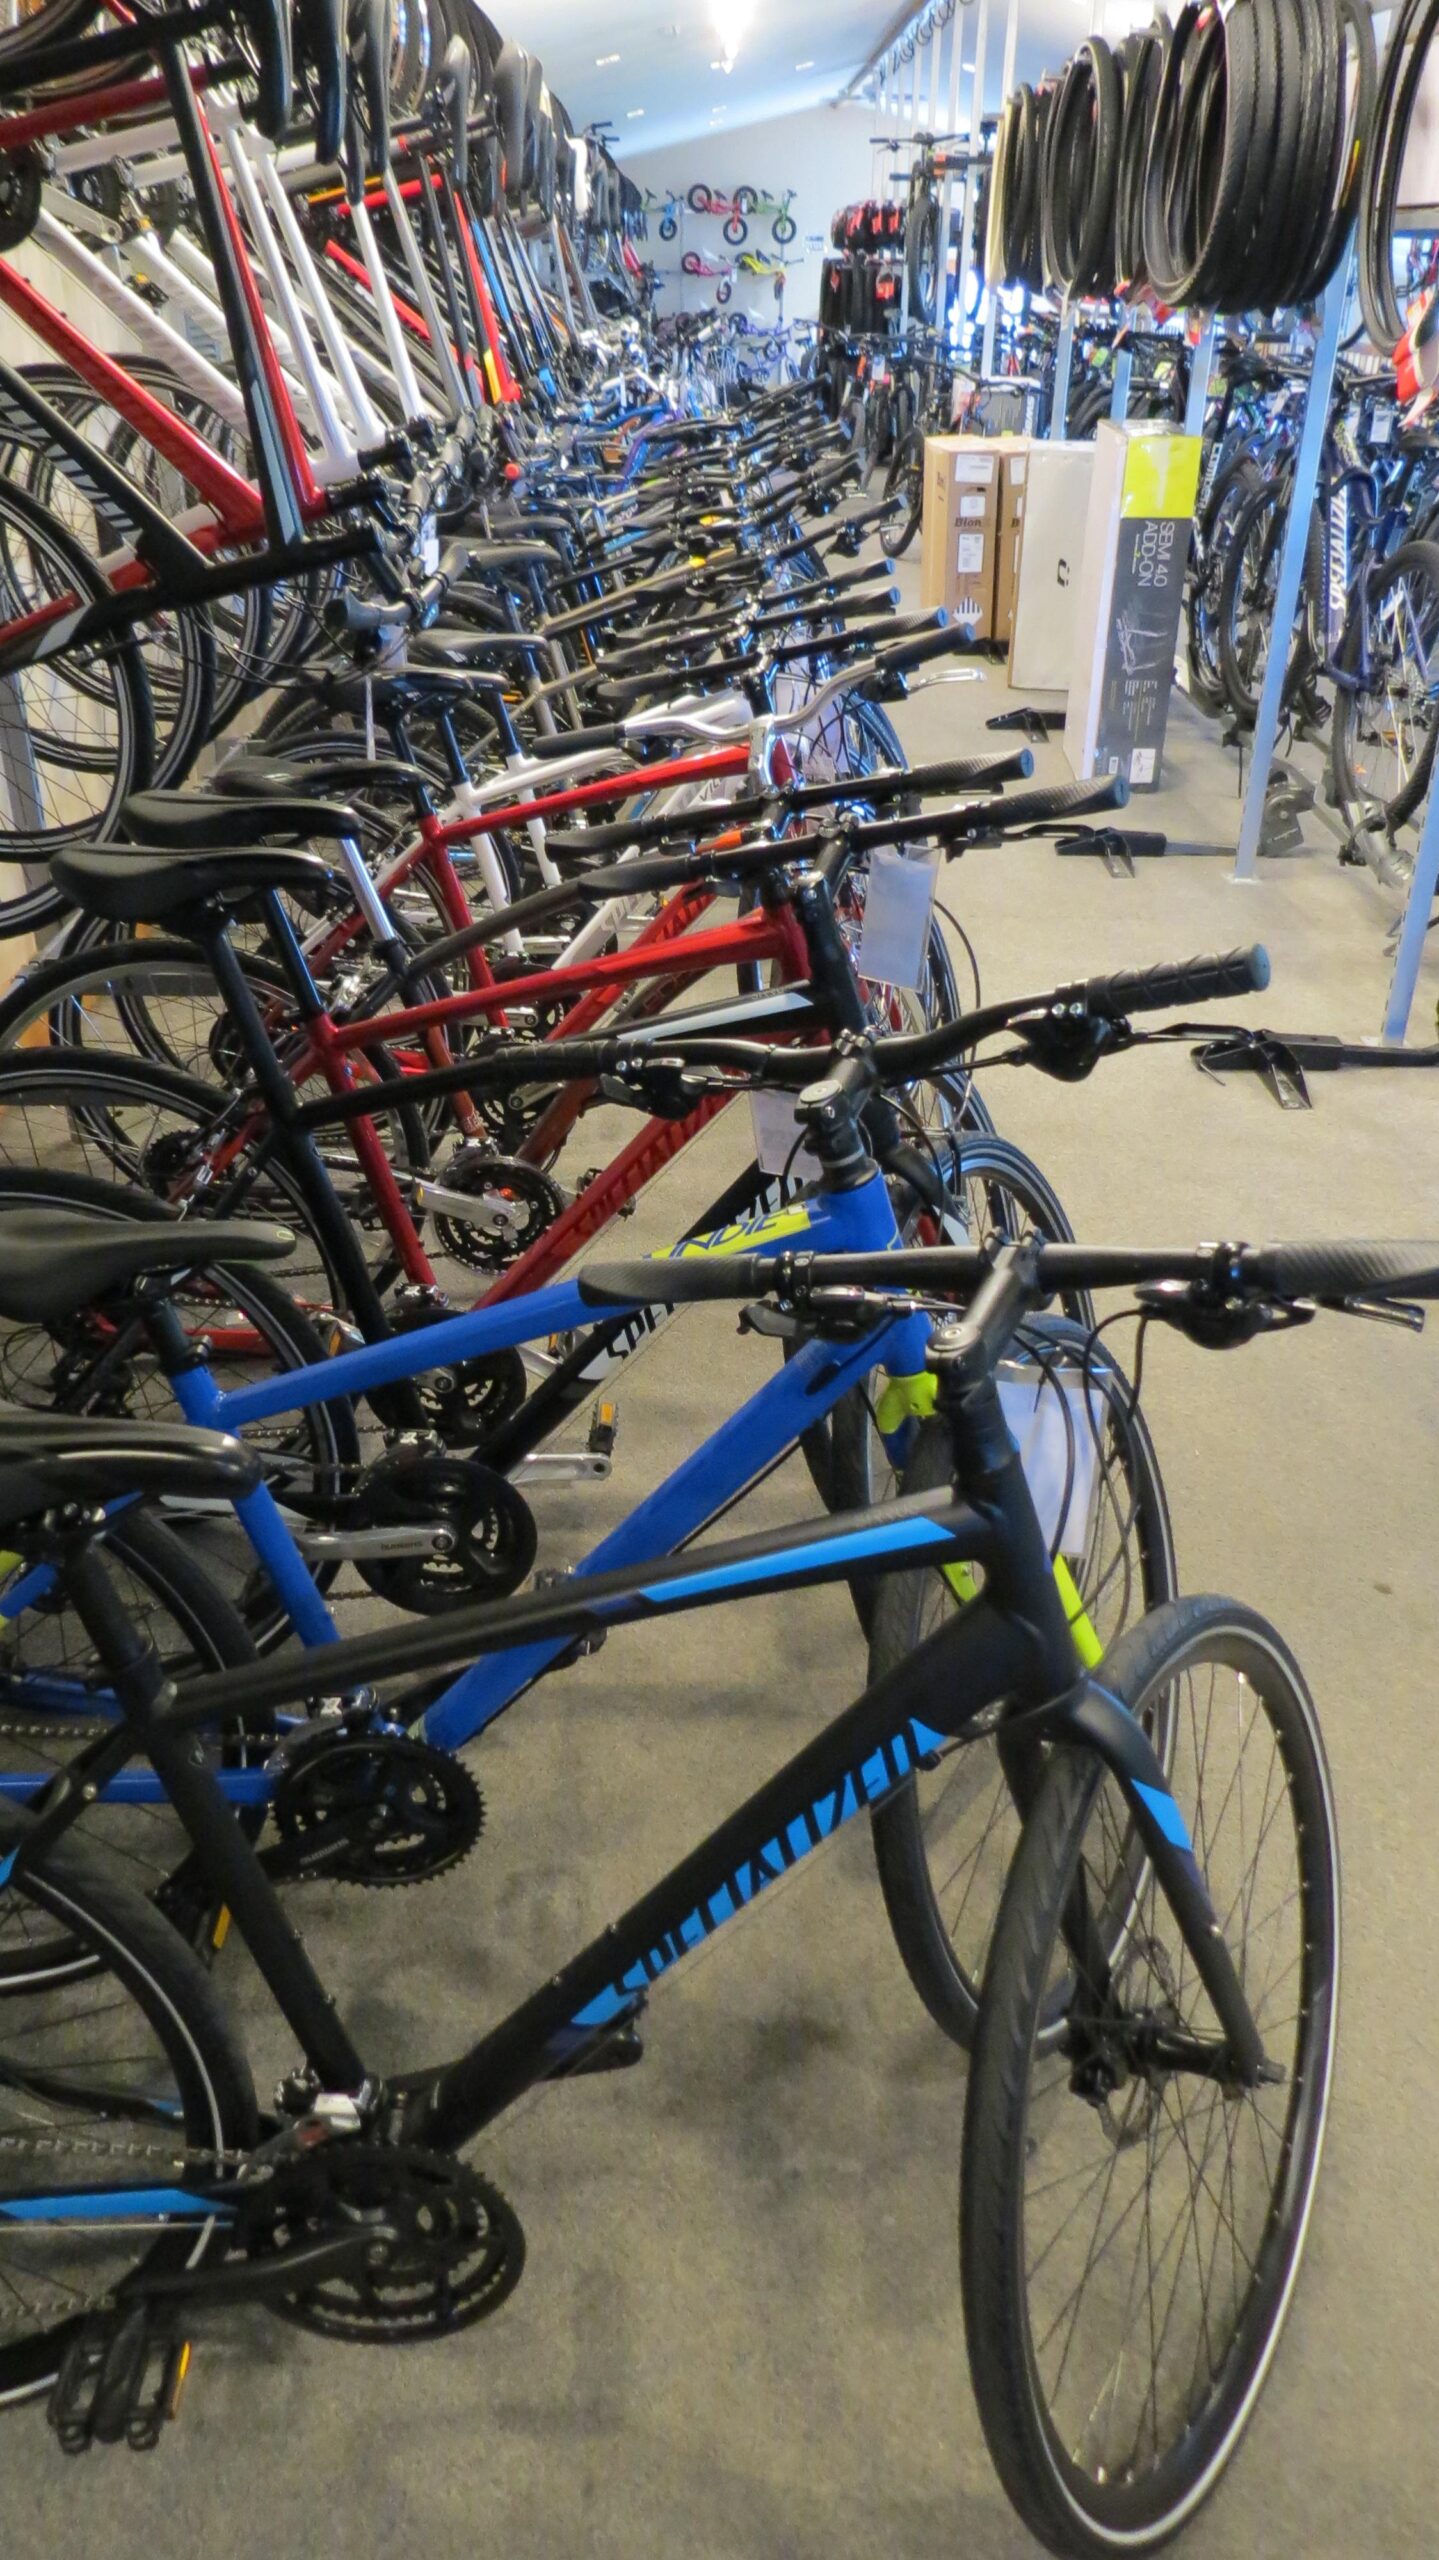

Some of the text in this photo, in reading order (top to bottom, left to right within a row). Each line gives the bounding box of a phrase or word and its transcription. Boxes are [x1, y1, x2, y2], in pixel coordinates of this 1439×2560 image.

[1137, 520, 1158, 587] ADD-ON
[1153, 521, 1175, 588] SEM 40
